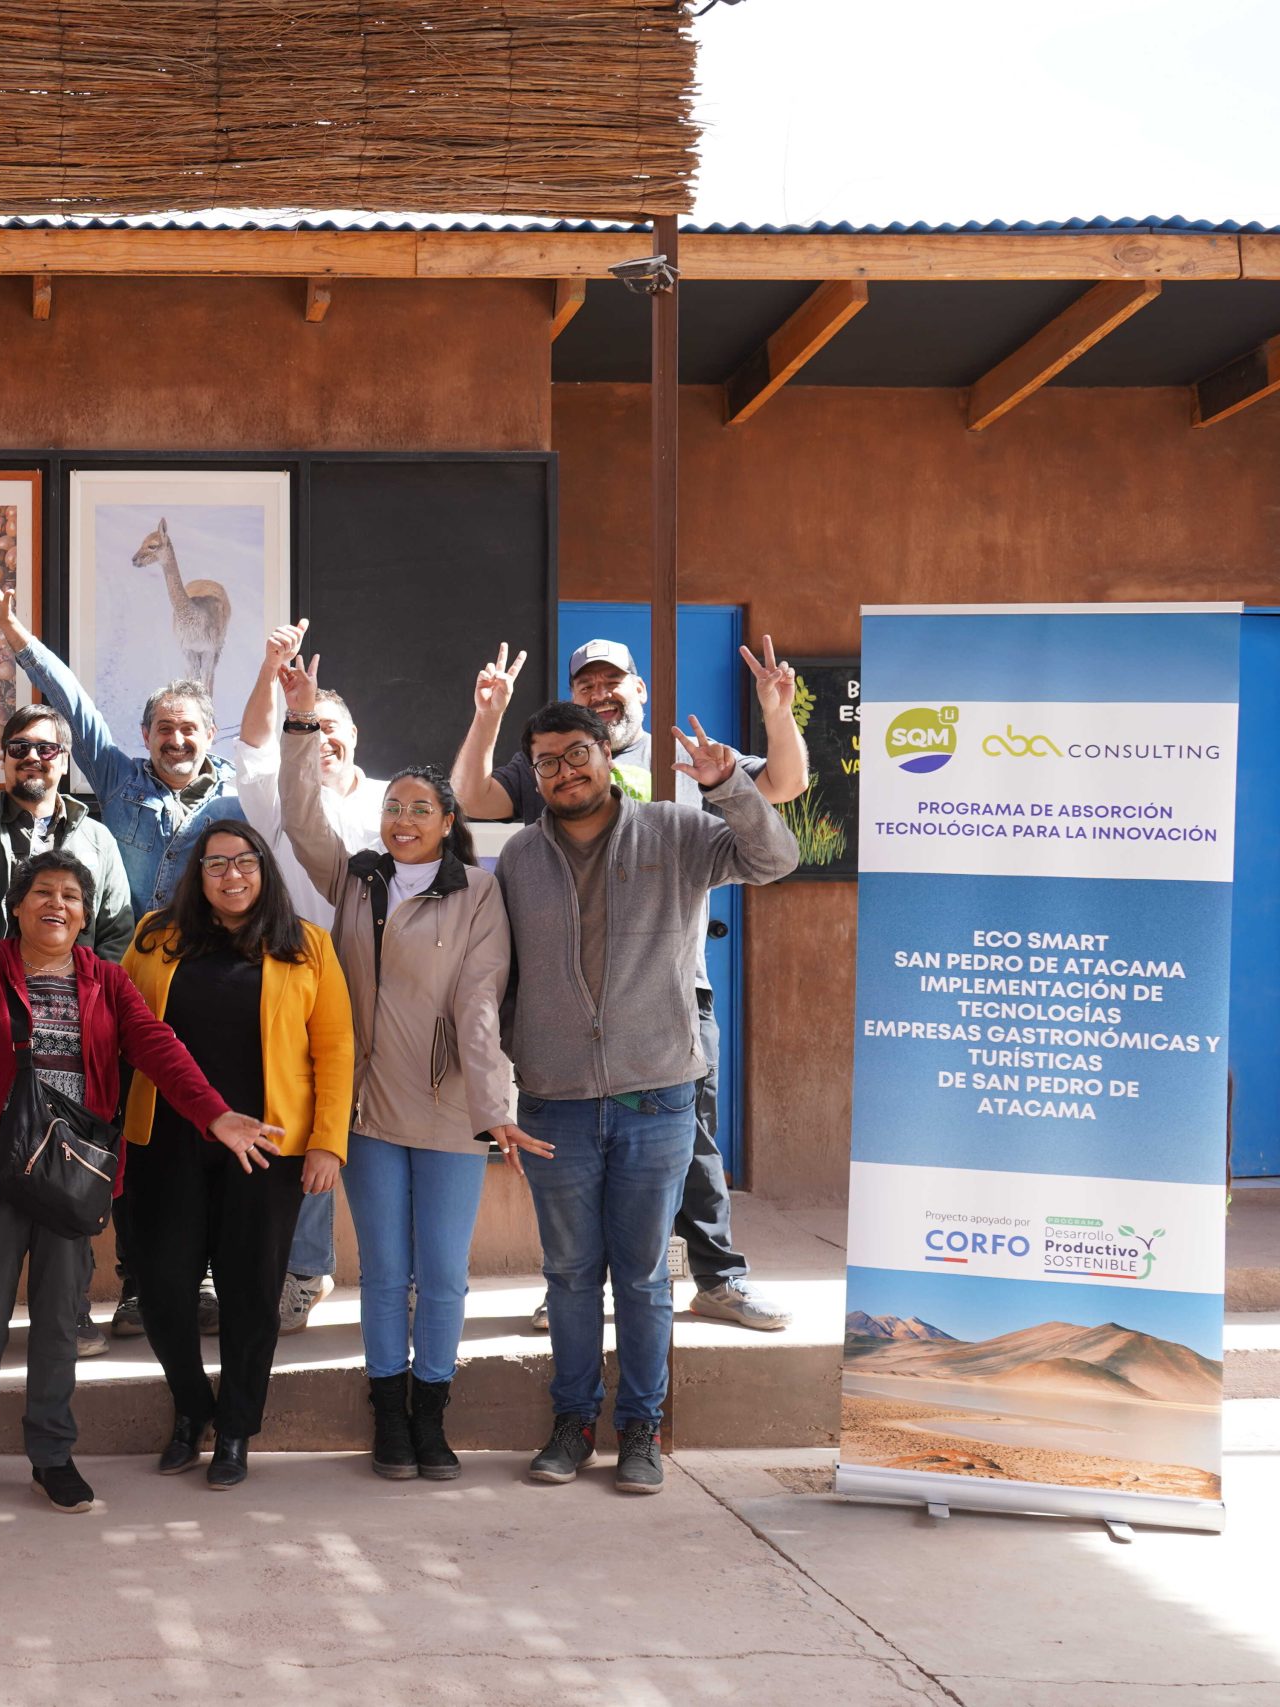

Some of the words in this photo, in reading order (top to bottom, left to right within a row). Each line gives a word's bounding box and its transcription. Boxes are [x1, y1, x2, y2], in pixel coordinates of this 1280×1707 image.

[945, 710, 954, 720] Li
[891, 728, 949, 748] SQM
[982, 724, 1064, 757] aba
[1068, 744, 1221, 760] CONSULTING
[918, 802, 1026, 818] PROGRAMA
[1031, 804, 1054, 817] DE
[1058, 802, 1173, 820] ABSORCIÓN
[875, 819, 1008, 838] TECNOLÓGICA
[1012, 825, 1060, 839] PARA
[1065, 826, 1087, 839] LA
[1092, 824, 1217, 842] INNOVACIÓN
[973, 931, 1021, 948] ECO
[1027, 932, 1109, 951] SMART
[894, 951, 940, 968] SAN
[947, 953, 1023, 972] PEDRO
[1029, 957, 1058, 974] DE
[1064, 959, 1186, 978] ATACAMA
[921, 975, 1126, 1000] IMPLEMENTACIÓN
[1133, 984, 1163, 1002] DE
[958, 1001, 1121, 1024] TECNOLOGÍAS
[864, 1020, 981, 1041] EMPRESAS
[987, 1025, 1200, 1051] GASTRONÓMICAS
[1204, 1037, 1220, 1053] Y
[968, 1047, 1102, 1071] TURÍSTICAS
[939, 1071, 966, 1089] DE
[972, 1073, 1019, 1091] SAN
[1026, 1076, 1103, 1096] PEDRO
[1110, 1080, 1139, 1097] DE
[977, 1098, 1096, 1119] ATACAMA
[925, 1210, 968, 1222] Proyecto
[971, 1215, 1012, 1225] apoyado
[1014, 1219, 1030, 1227] por
[1047, 1218, 1101, 1226] PROGRAMA
[925, 1230, 1030, 1256] CORFO
[1045, 1227, 1113, 1241] Desarrollo
[1045, 1240, 1138, 1258] Productivo
[1044, 1255, 1136, 1272] SOSTENIBLE
